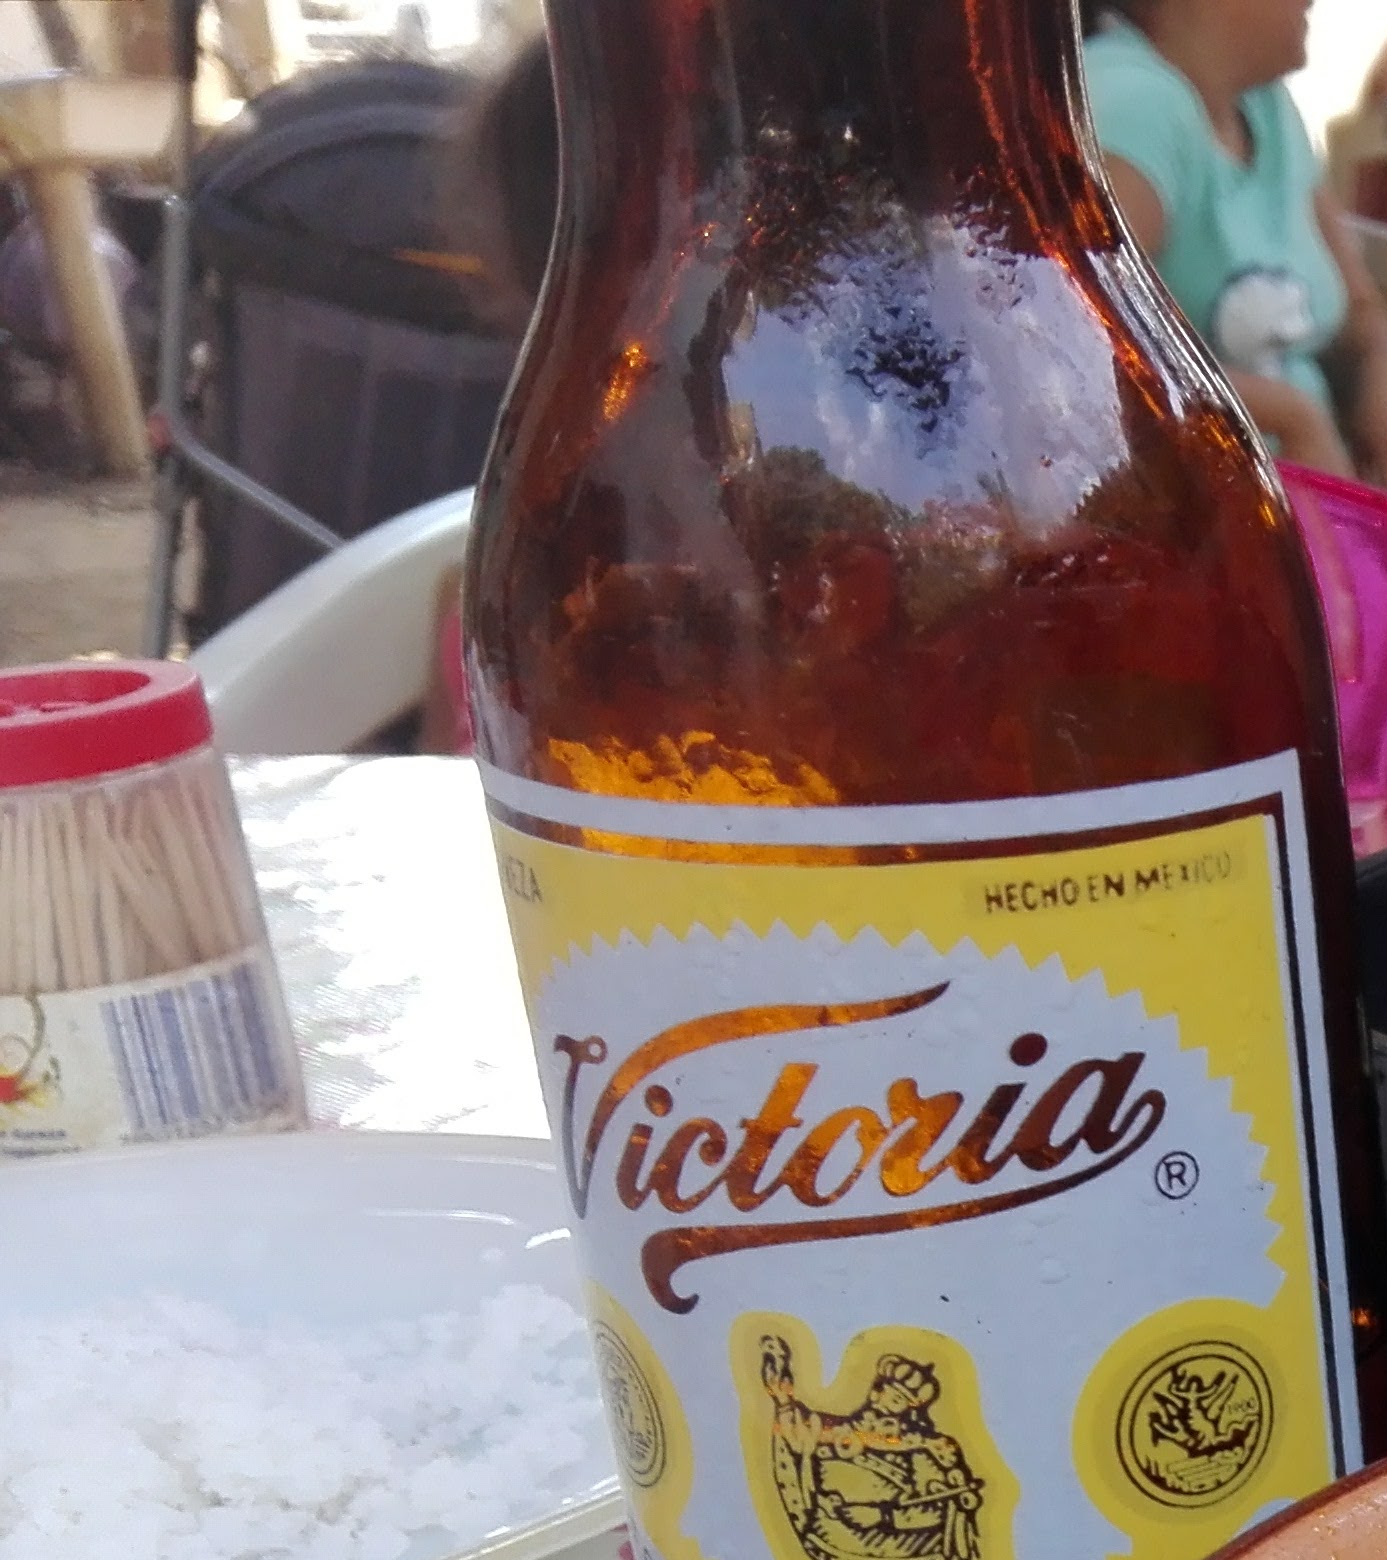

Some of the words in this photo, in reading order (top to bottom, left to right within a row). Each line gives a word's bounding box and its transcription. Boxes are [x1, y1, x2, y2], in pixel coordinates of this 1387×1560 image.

[984, 876, 1080, 914] HECHO
[1086, 872, 1126, 904] EN
[553, 979, 1167, 1316] Victoria
